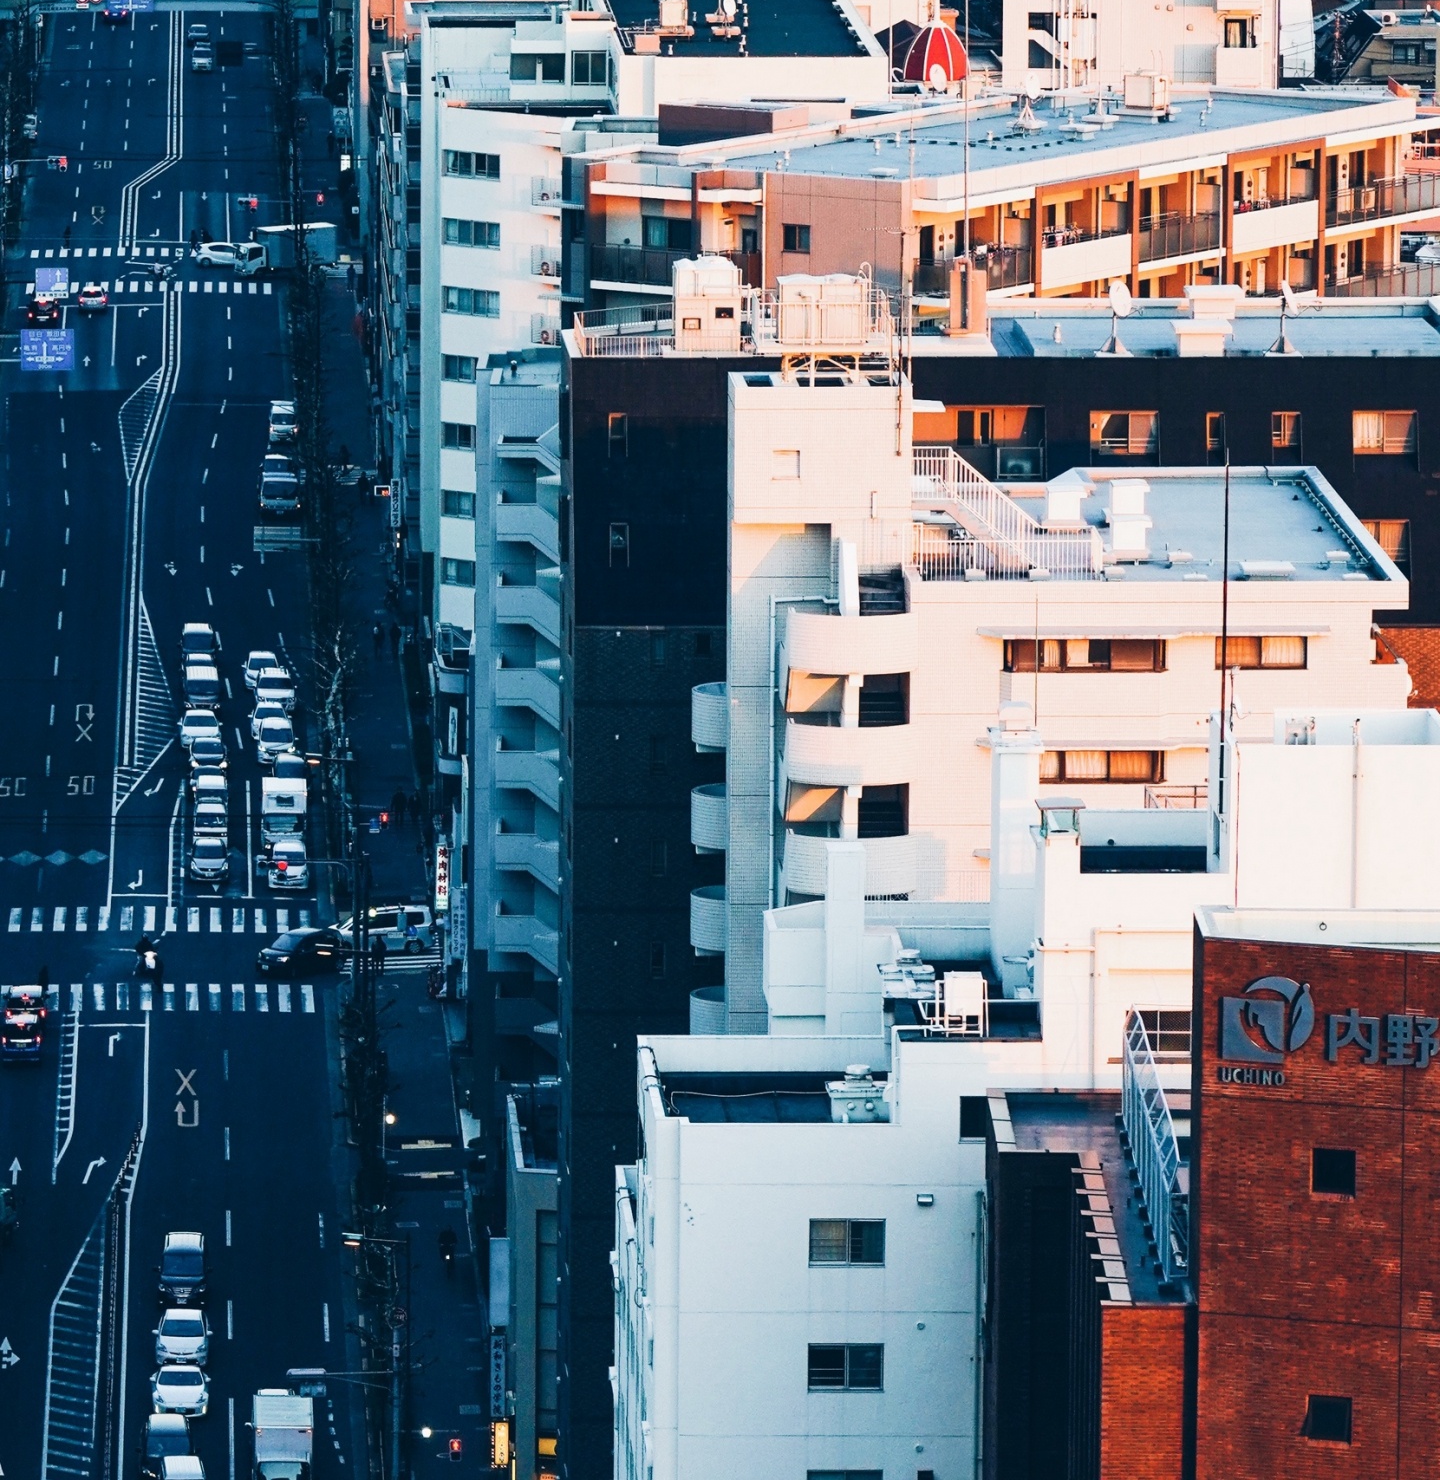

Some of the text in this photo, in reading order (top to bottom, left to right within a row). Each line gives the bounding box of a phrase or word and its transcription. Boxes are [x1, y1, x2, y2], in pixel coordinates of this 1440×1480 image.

[93, 160, 112, 170] 50
[67, 775, 95, 795] 50
[1327, 1008, 1440, 1069] 内野
[1220, 1067, 1286, 1086] UCHINO
